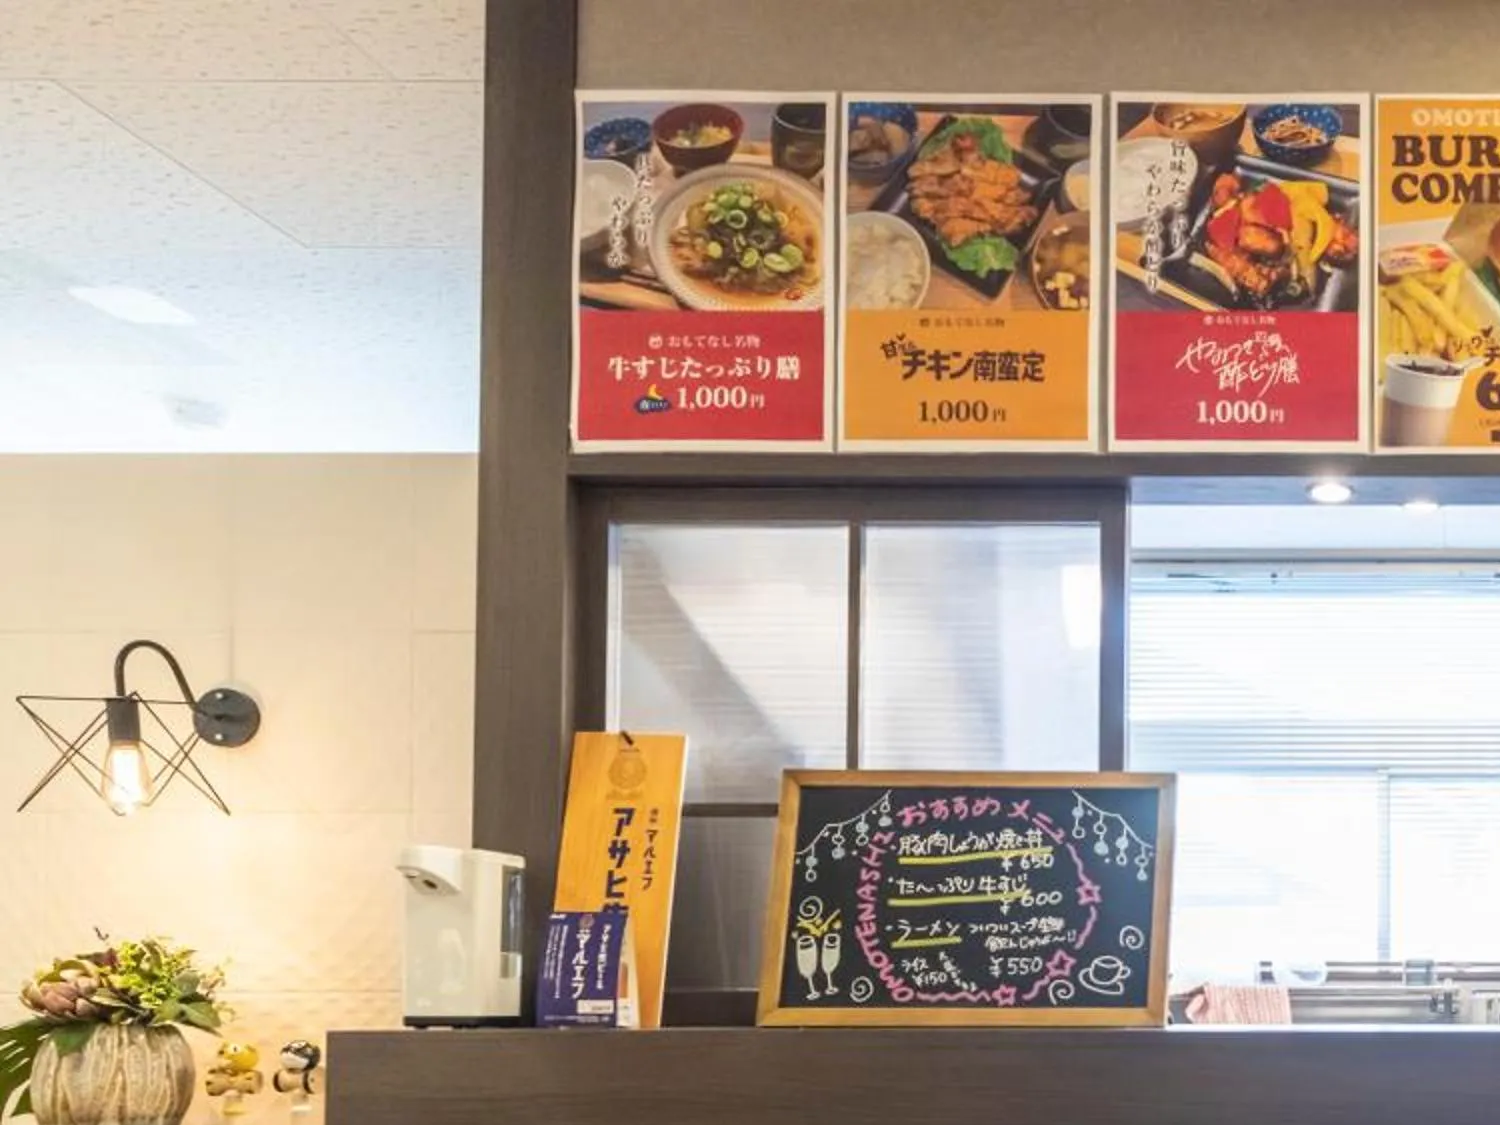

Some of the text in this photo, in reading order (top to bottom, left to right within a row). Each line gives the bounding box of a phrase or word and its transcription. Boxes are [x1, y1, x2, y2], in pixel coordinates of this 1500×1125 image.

[608, 356, 801, 380] 牛すじたっぷり膳
[677, 385, 765, 410] 1,000円
[918, 401, 1006, 424] 1,000円
[1195, 400, 1285, 425] 1,000円
[896, 918, 961, 940] ラーメン
